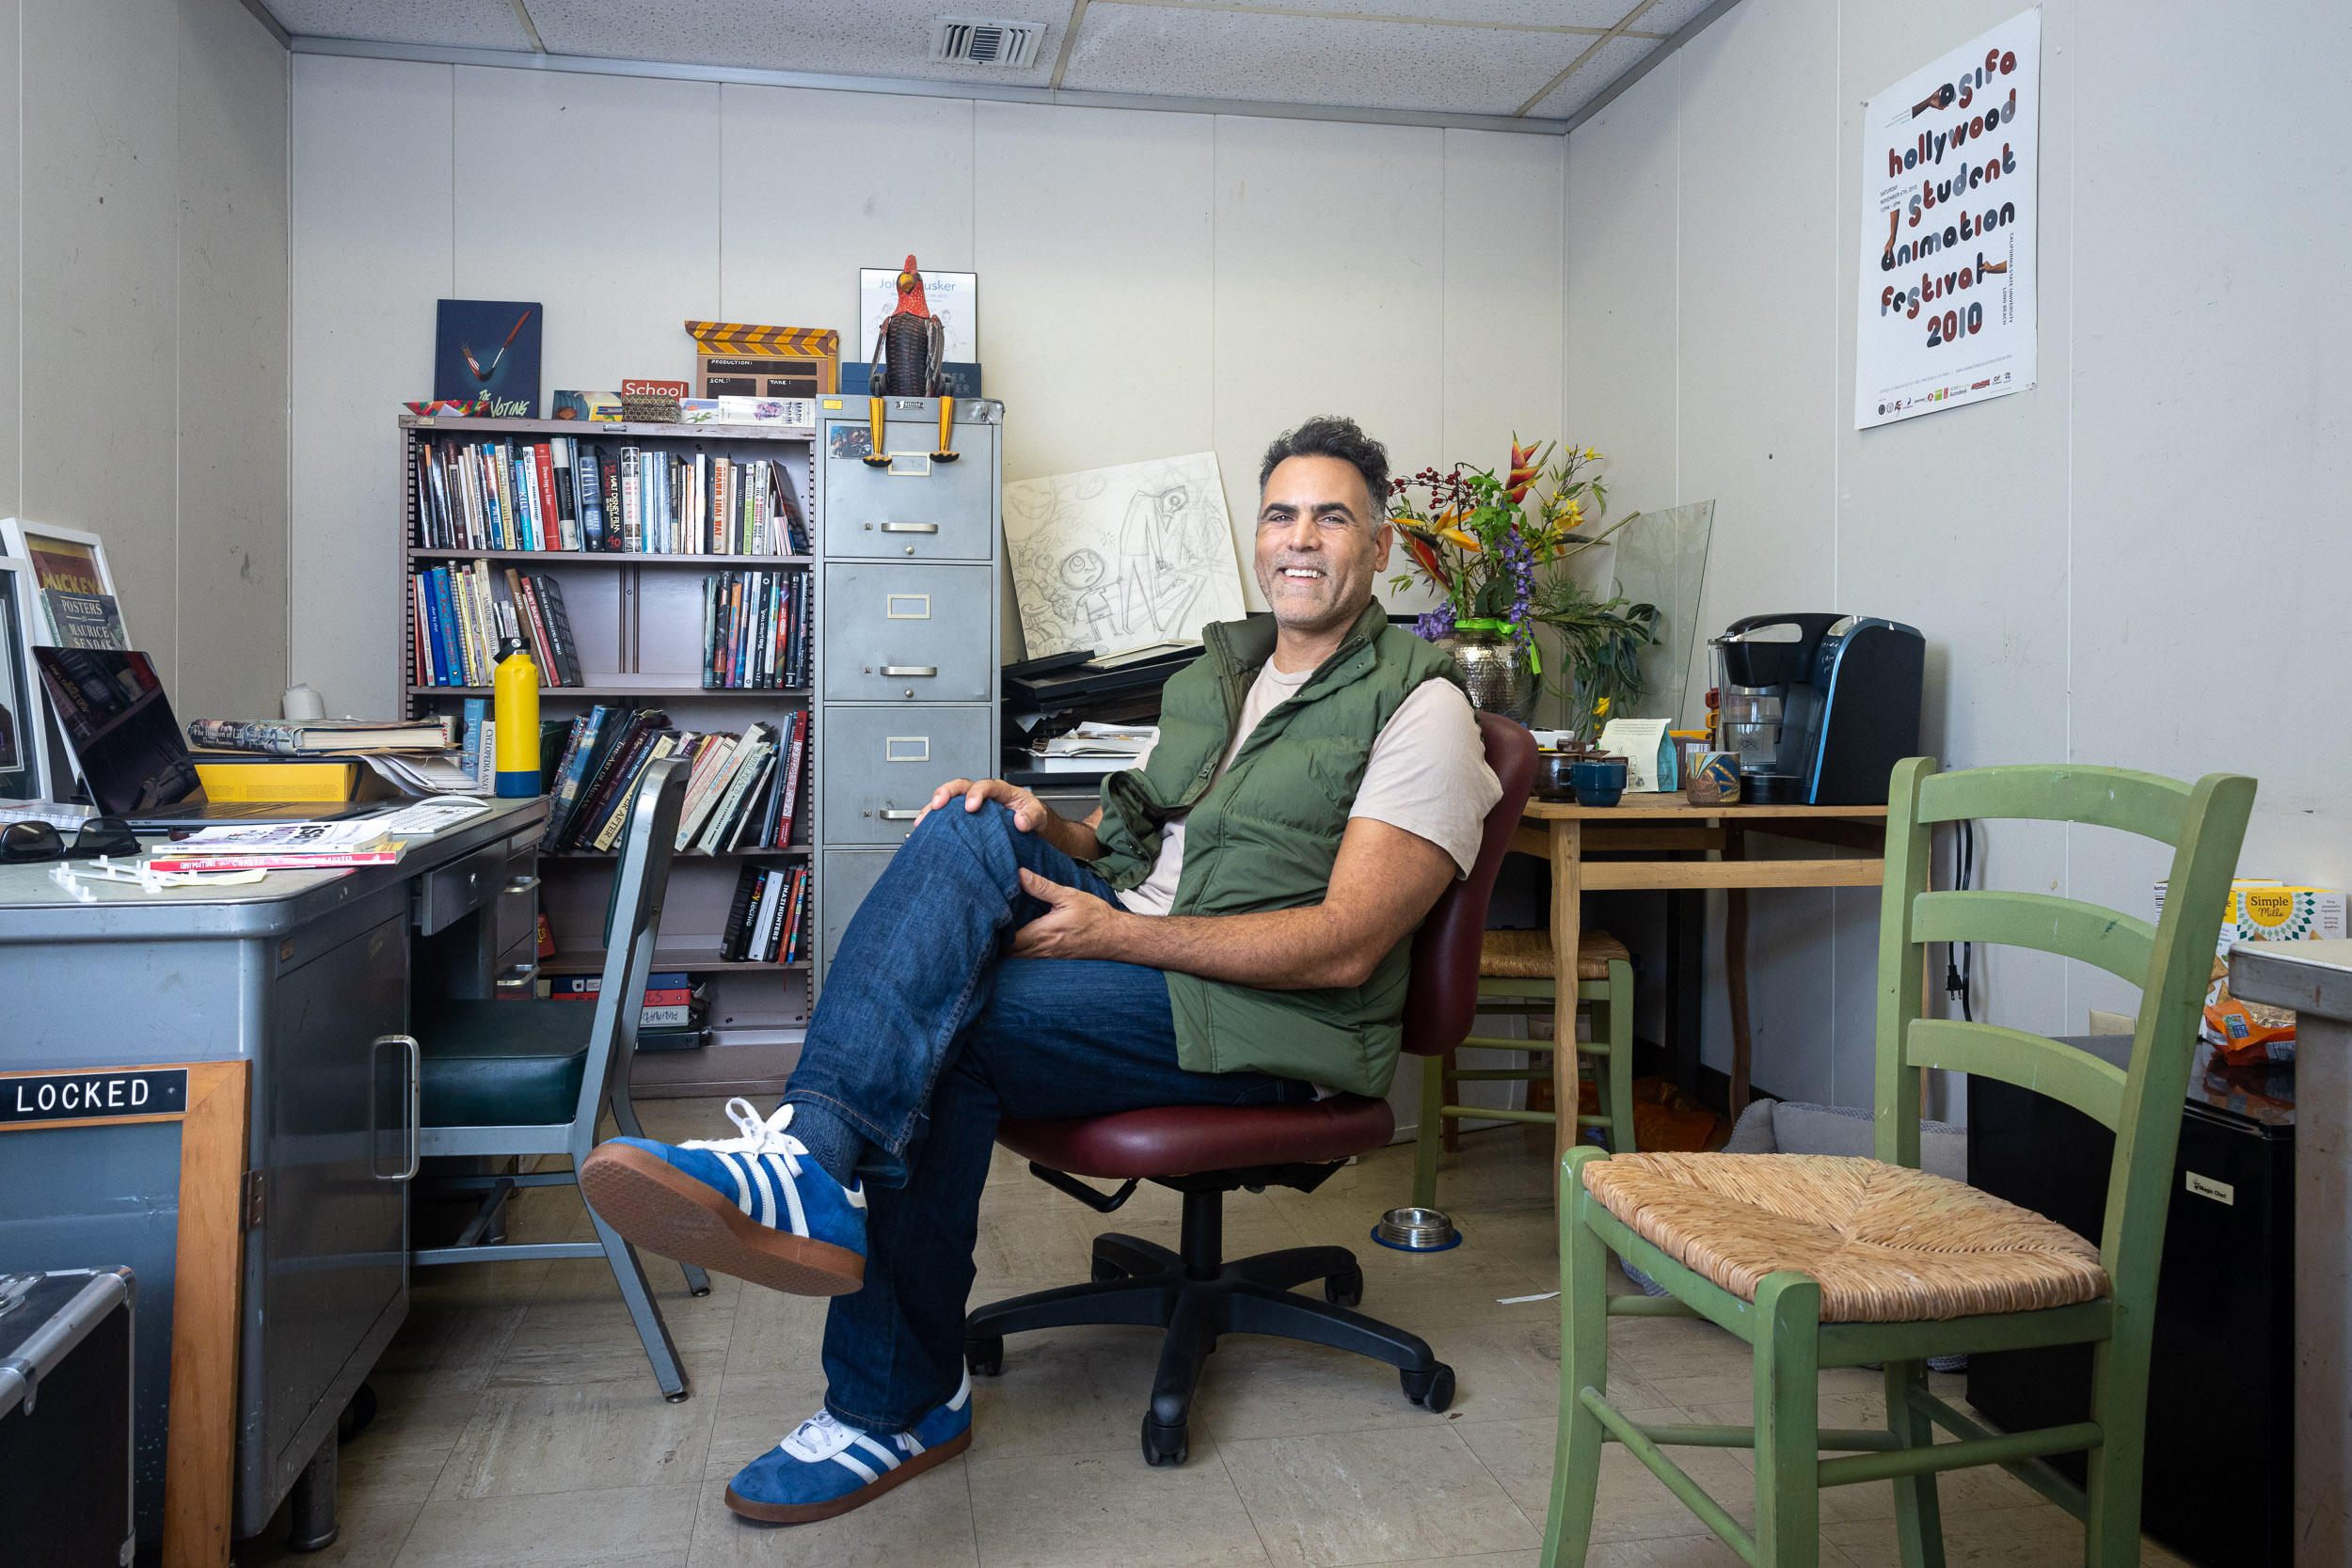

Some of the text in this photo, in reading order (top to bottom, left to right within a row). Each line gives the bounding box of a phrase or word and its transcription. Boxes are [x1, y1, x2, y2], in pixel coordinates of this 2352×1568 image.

[1889, 87, 2016, 178] hollywood
[1880, 184, 1899, 197] SATURDAY
[1909, 143, 2016, 227] student
[1880, 193, 1900, 205] NOVEMBER
[1882, 202, 2014, 271] animation
[879, 278, 897, 289] Joh
[1881, 252, 1983, 319] festival
[1927, 302, 1982, 348] 2010
[625, 382, 684, 398] School
[541, 466, 549, 487] Drawing
[580, 459, 598, 500] STORY
[518, 490, 528, 510] KILL
[714, 520, 723, 535] WAY
[61, 600, 103, 615] POSTERS
[468, 596, 477, 625] PERFORMANCE
[514, 591, 523, 610] ASIFA
[524, 584, 542, 627] PLANET BANKSY
[69, 624, 109, 638] MAURICE
[443, 622, 453, 640] CHUCK
[74, 638, 112, 650] SENDAK
[193, 724, 204, 736] The
[468, 715, 477, 737] THE
[482, 729, 493, 771] CYCLOPEDIA
[638, 745, 650, 759] OVER
[580, 738, 626, 810] THE ART OF MULAN
[627, 764, 638, 780] MOON
[603, 809, 625, 838] AFTER
[752, 875, 766, 901] fuzzy
[2250, 896, 2289, 908] Simple
[746, 901, 757, 927] techie
[771, 887, 788, 941] NAZI HUNTERS
[17, 1079, 149, 1112] LOCKED
[2200, 1185, 2227, 1198] Magic Chef
